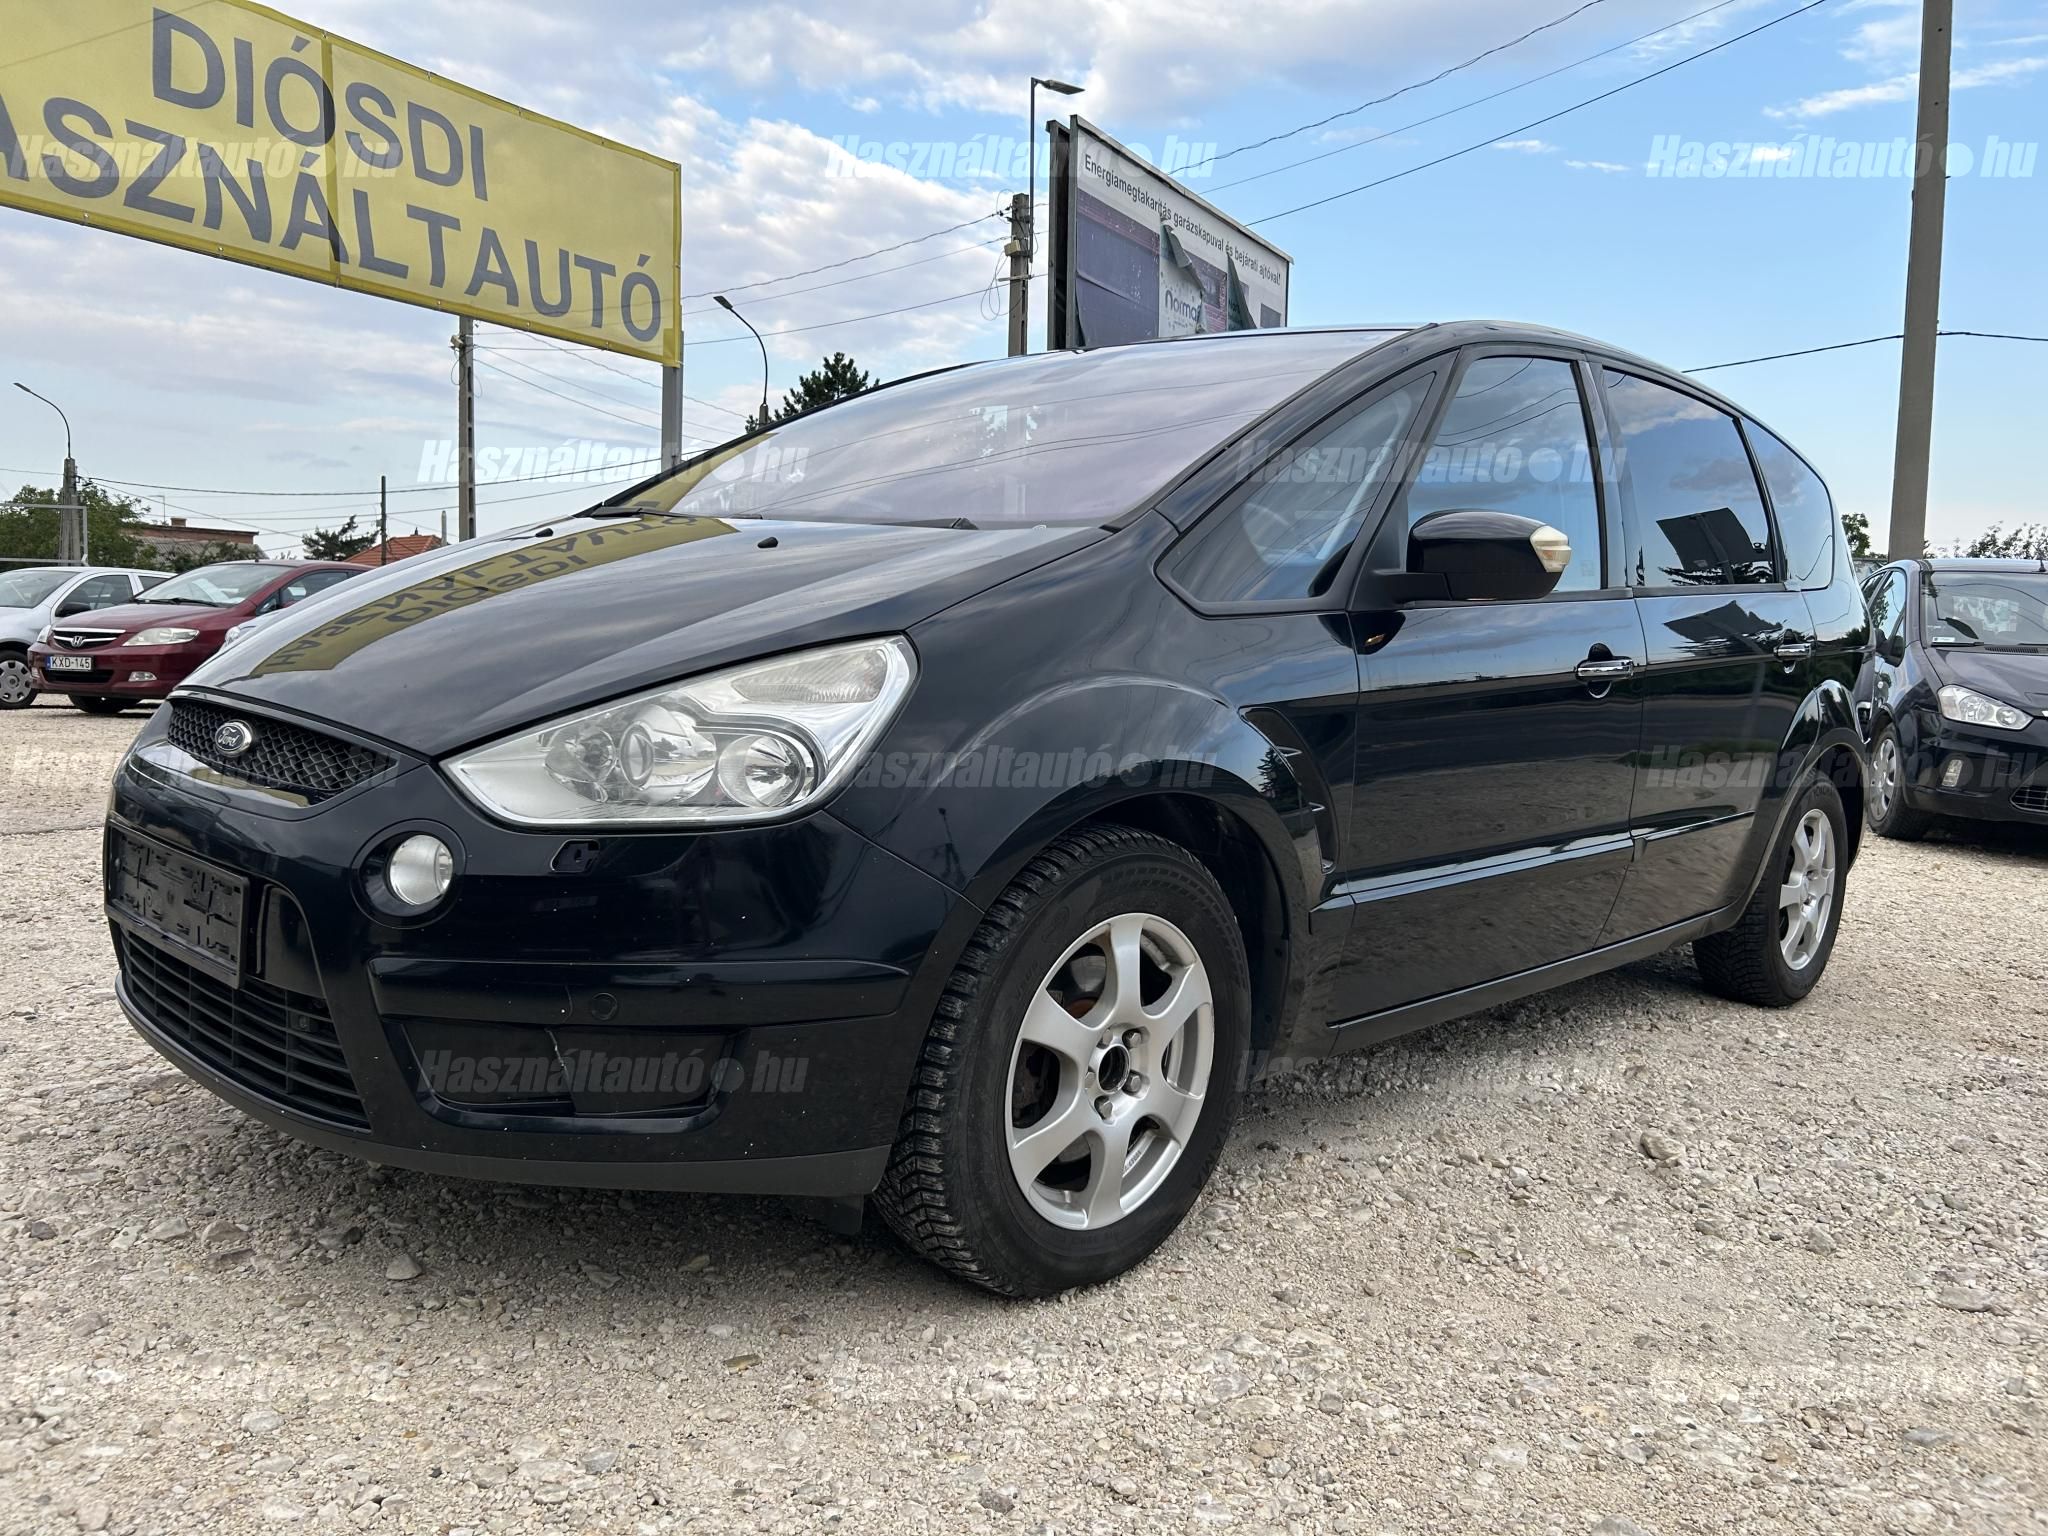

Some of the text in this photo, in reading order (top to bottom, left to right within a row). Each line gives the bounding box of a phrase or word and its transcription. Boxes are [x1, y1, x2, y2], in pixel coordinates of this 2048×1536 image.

[152, 7, 488, 201] DIÓSDI
[1173, 211, 1224, 252] garázskapuval
[51, 657, 91, 669] KXD-145
[217, 726, 241, 747] Ford
